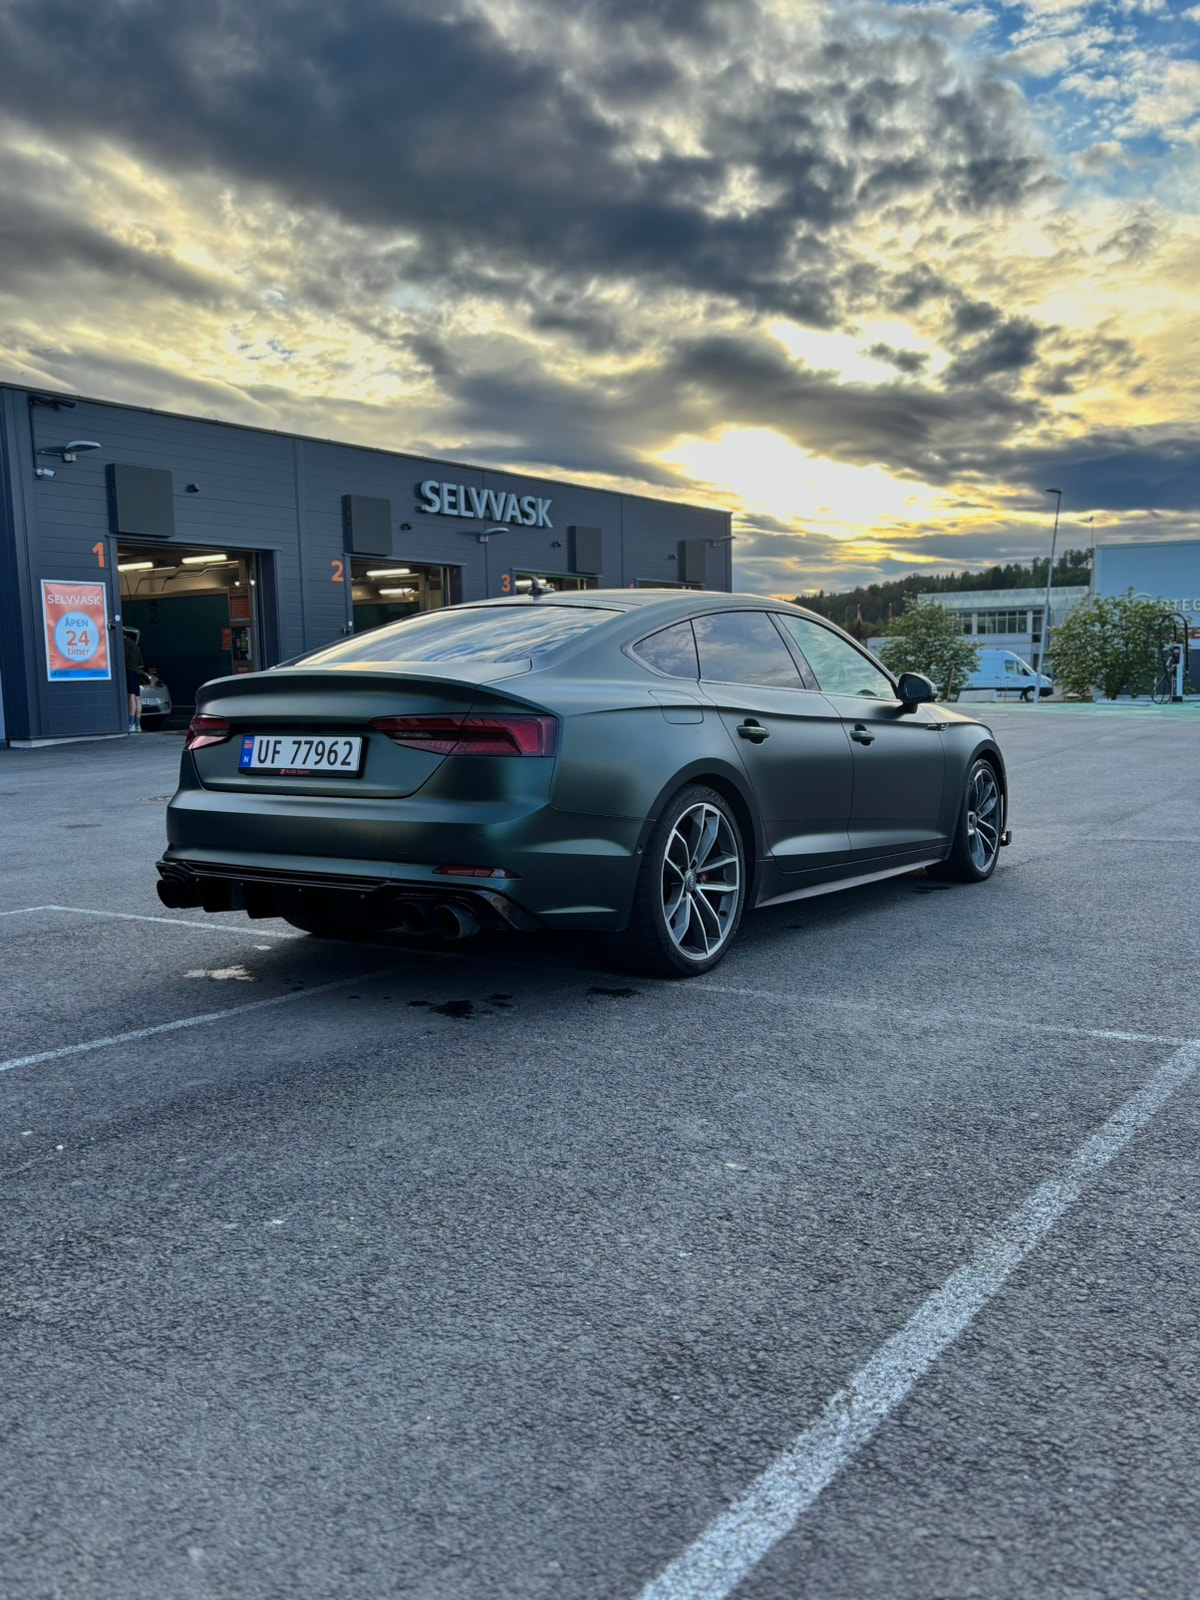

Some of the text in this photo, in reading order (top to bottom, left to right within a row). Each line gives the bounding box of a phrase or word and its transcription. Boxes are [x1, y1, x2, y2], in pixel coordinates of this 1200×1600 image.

[420, 479, 553, 528] SELVVASK
[92, 542, 105, 568] 1
[330, 560, 344, 582] 2
[501, 574, 511, 592] 3
[47, 594, 101, 606] SELVVASK
[64, 617, 89, 628] ÅPEN
[65, 630, 90, 647] 24
[67, 648, 90, 656] timer
[257, 740, 353, 766] UF 77962
